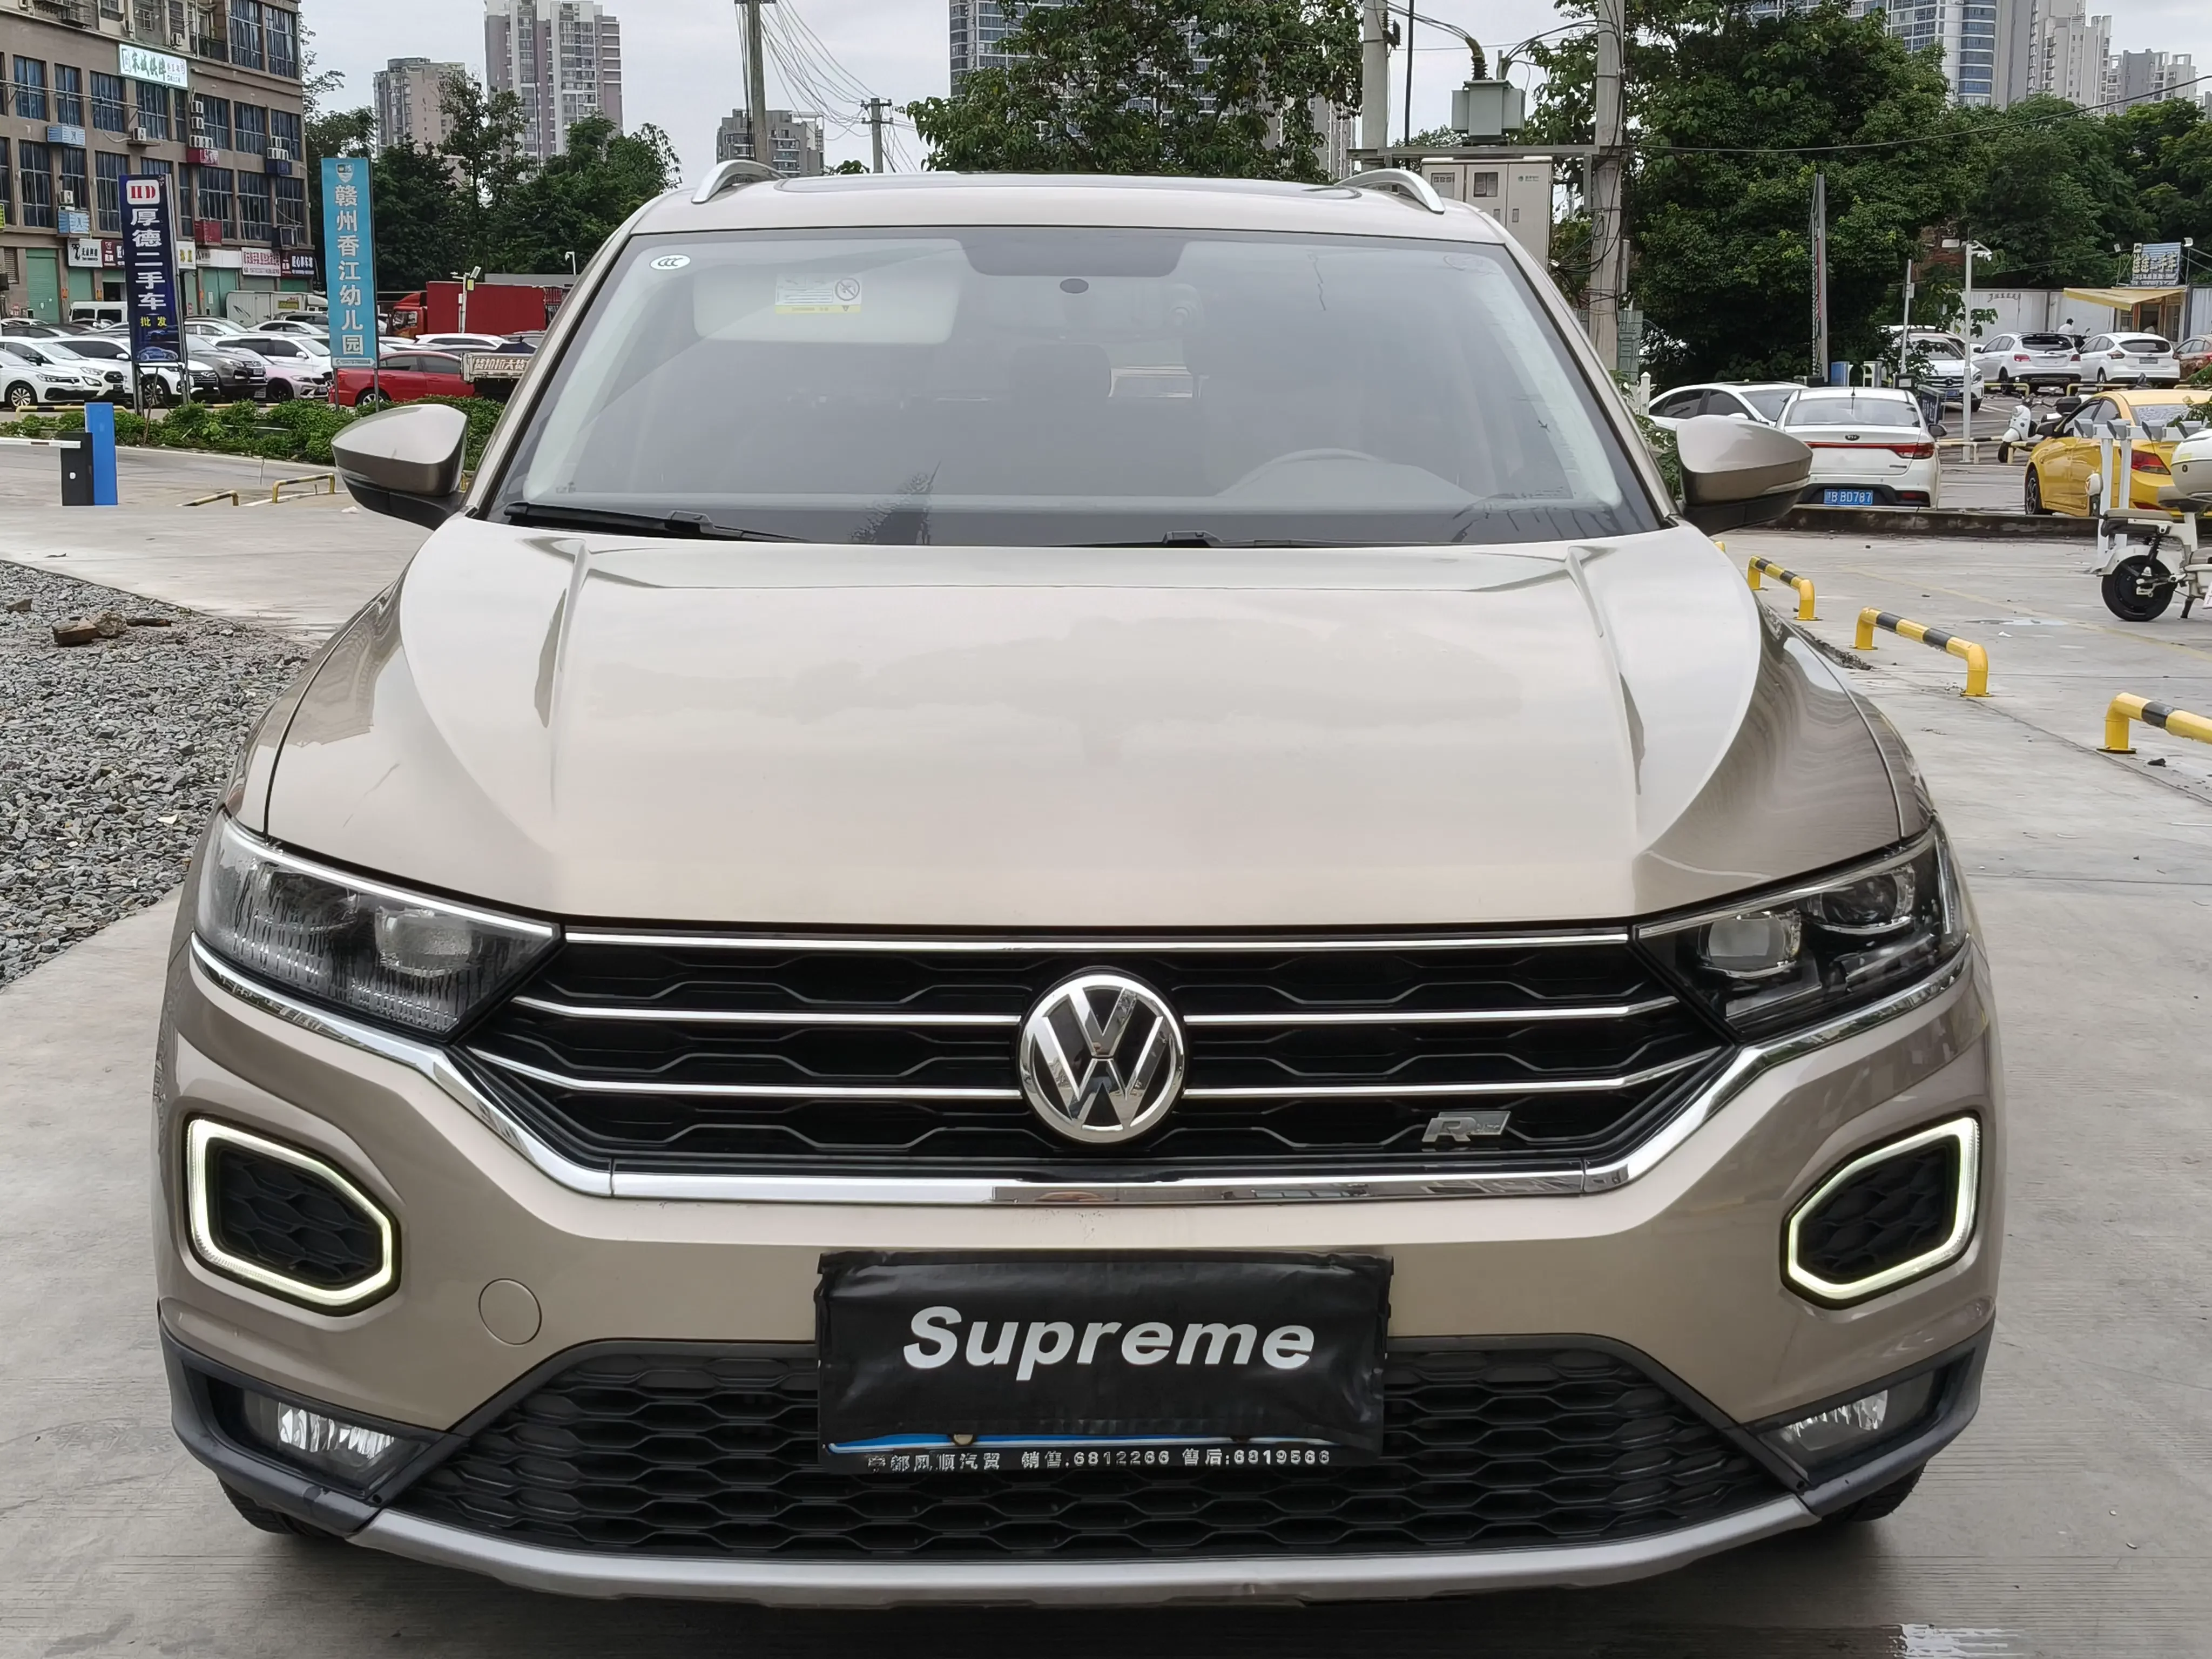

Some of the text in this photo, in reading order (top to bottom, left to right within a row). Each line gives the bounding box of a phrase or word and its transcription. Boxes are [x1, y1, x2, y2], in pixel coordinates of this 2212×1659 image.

[131, 208, 166, 310] 厚德二手车
[334, 184, 364, 356] 赣州香江幼儿园
[140, 316, 167, 327] 批发
[903, 1306, 1315, 1381] Supreme
